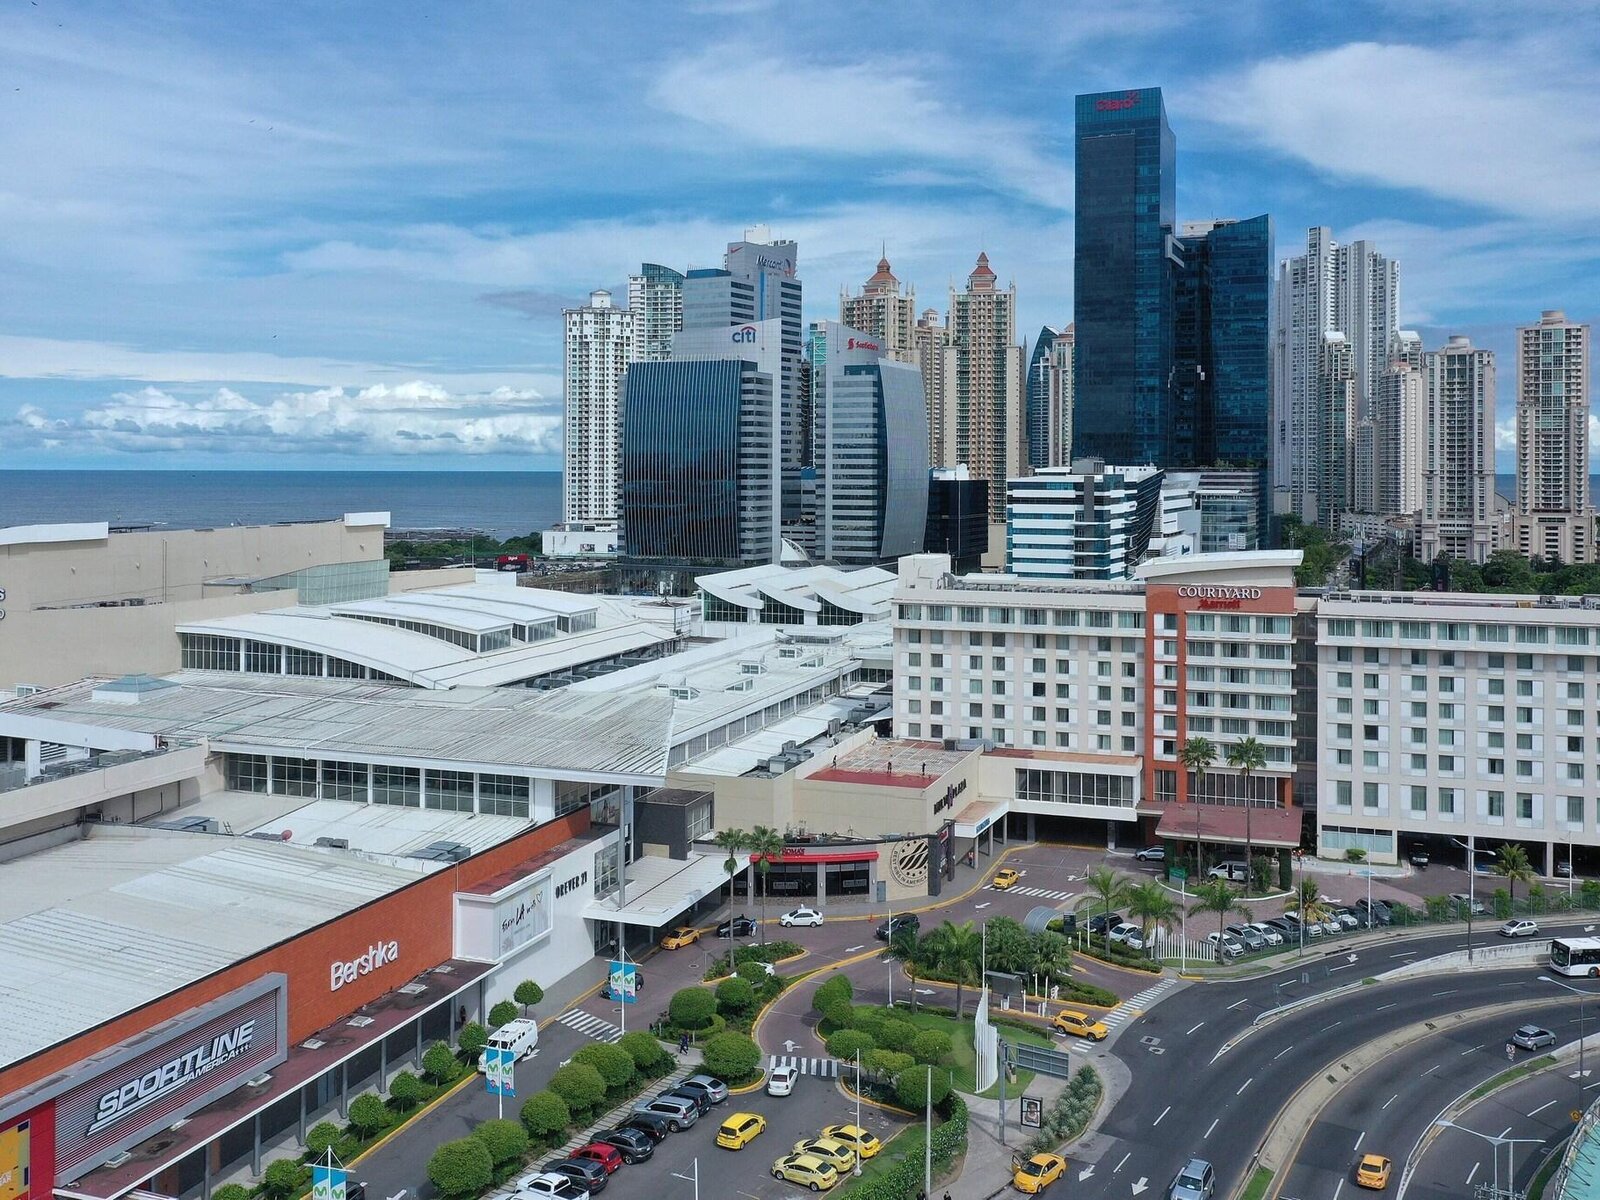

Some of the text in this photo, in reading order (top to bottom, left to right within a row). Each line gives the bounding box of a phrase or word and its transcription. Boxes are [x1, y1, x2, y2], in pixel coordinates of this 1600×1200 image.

[732, 329, 756, 343] citi
[1178, 586, 1261, 600] COURTYARD
[555, 871, 588, 899] OREVER 21
[330, 940, 398, 992] Bershka
[97, 1019, 256, 1121] SPORTLINE
[186, 1050, 237, 1083] AMERICA
